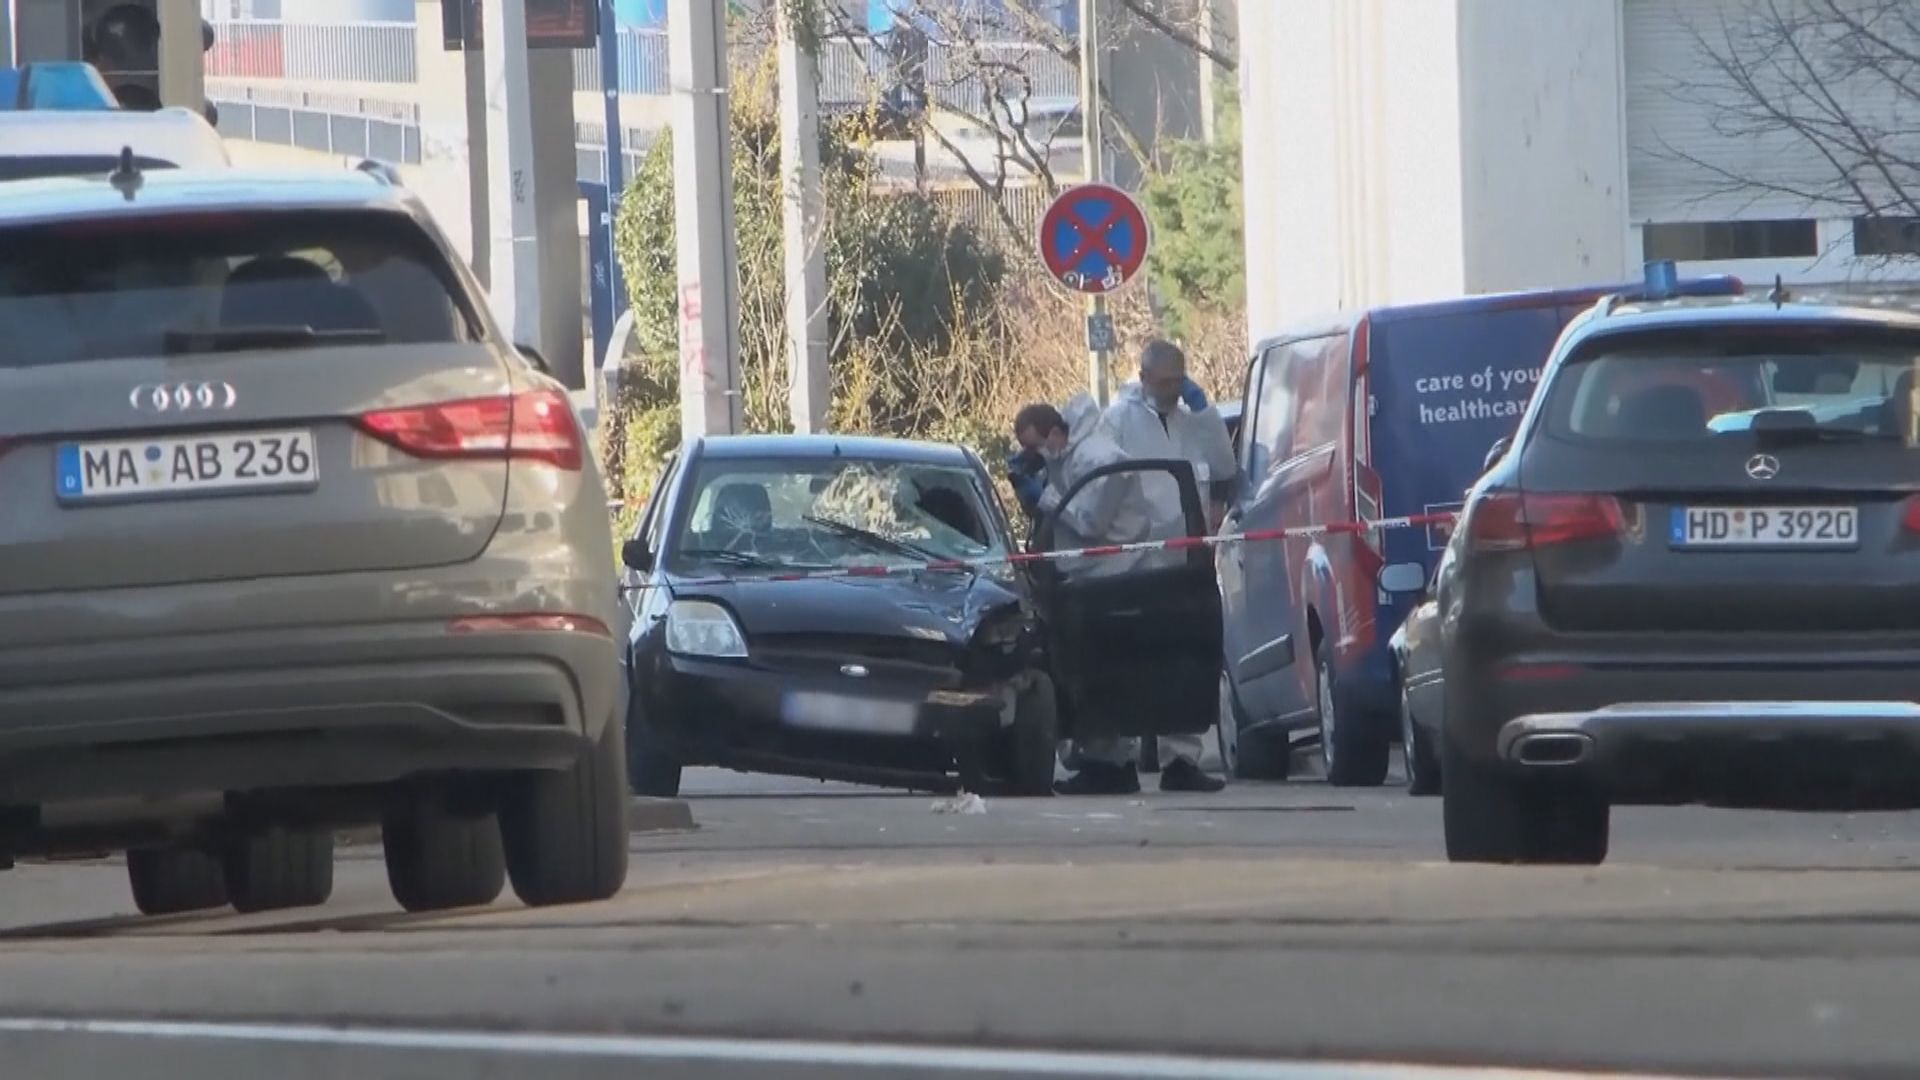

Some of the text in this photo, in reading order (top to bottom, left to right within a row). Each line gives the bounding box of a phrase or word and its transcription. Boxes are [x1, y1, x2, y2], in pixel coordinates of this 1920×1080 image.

[1416, 374, 1464, 393] care
[1470, 365, 1493, 392] of
[84, 448, 139, 488] MA
[171, 442, 222, 482] AB
[232, 437, 310, 478] 236
[1689, 510, 1729, 539] HD
[1751, 511, 1769, 539] P
[1777, 510, 1853, 539] 3920
